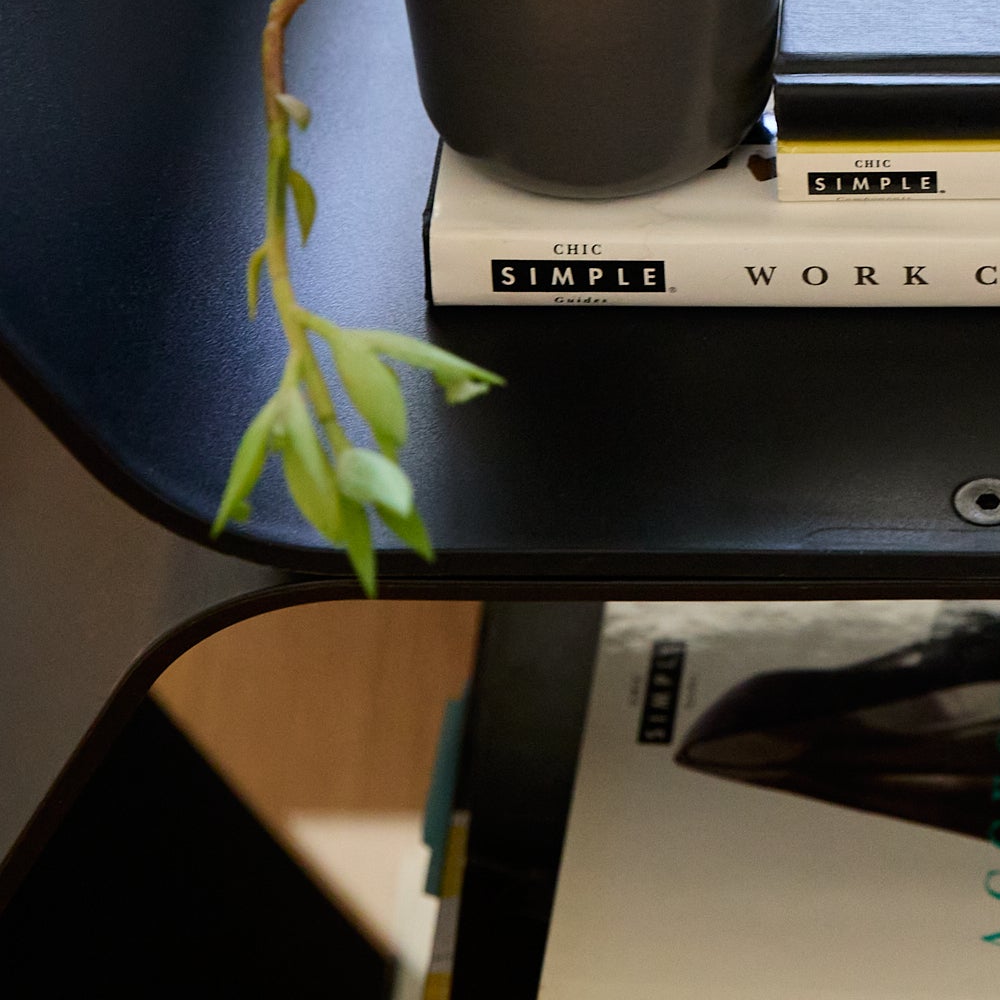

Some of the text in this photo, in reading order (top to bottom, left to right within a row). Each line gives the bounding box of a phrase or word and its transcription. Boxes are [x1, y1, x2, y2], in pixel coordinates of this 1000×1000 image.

[854, 159, 892, 169] CHIC
[814, 176, 932, 192] SIMPLE
[552, 243, 604, 257] CHIC
[500, 266, 658, 287] SIMPLE
[744, 264, 930, 287] WORK
